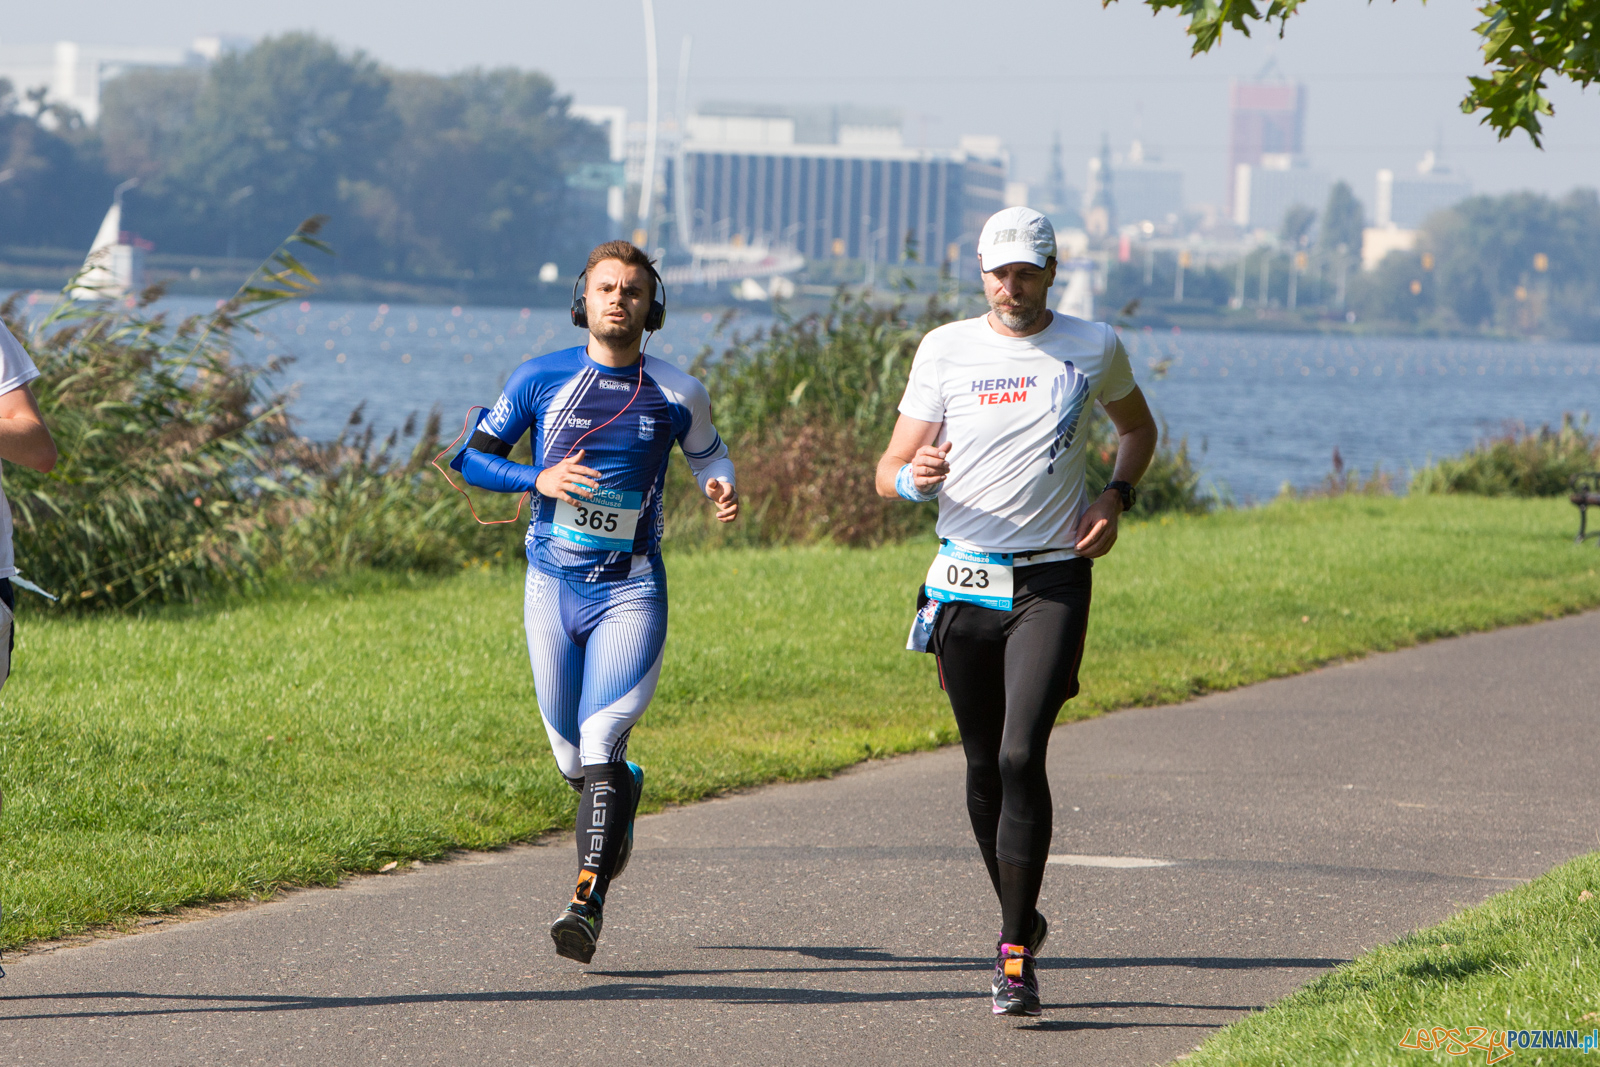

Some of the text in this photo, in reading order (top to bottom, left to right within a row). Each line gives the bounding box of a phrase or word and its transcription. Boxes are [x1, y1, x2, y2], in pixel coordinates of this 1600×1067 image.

[971, 375, 1038, 392] HERNIK
[978, 390, 1027, 406] TEAM
[574, 507, 619, 532] 365
[955, 552, 990, 563] FUNdusze
[947, 564, 990, 589] 023
